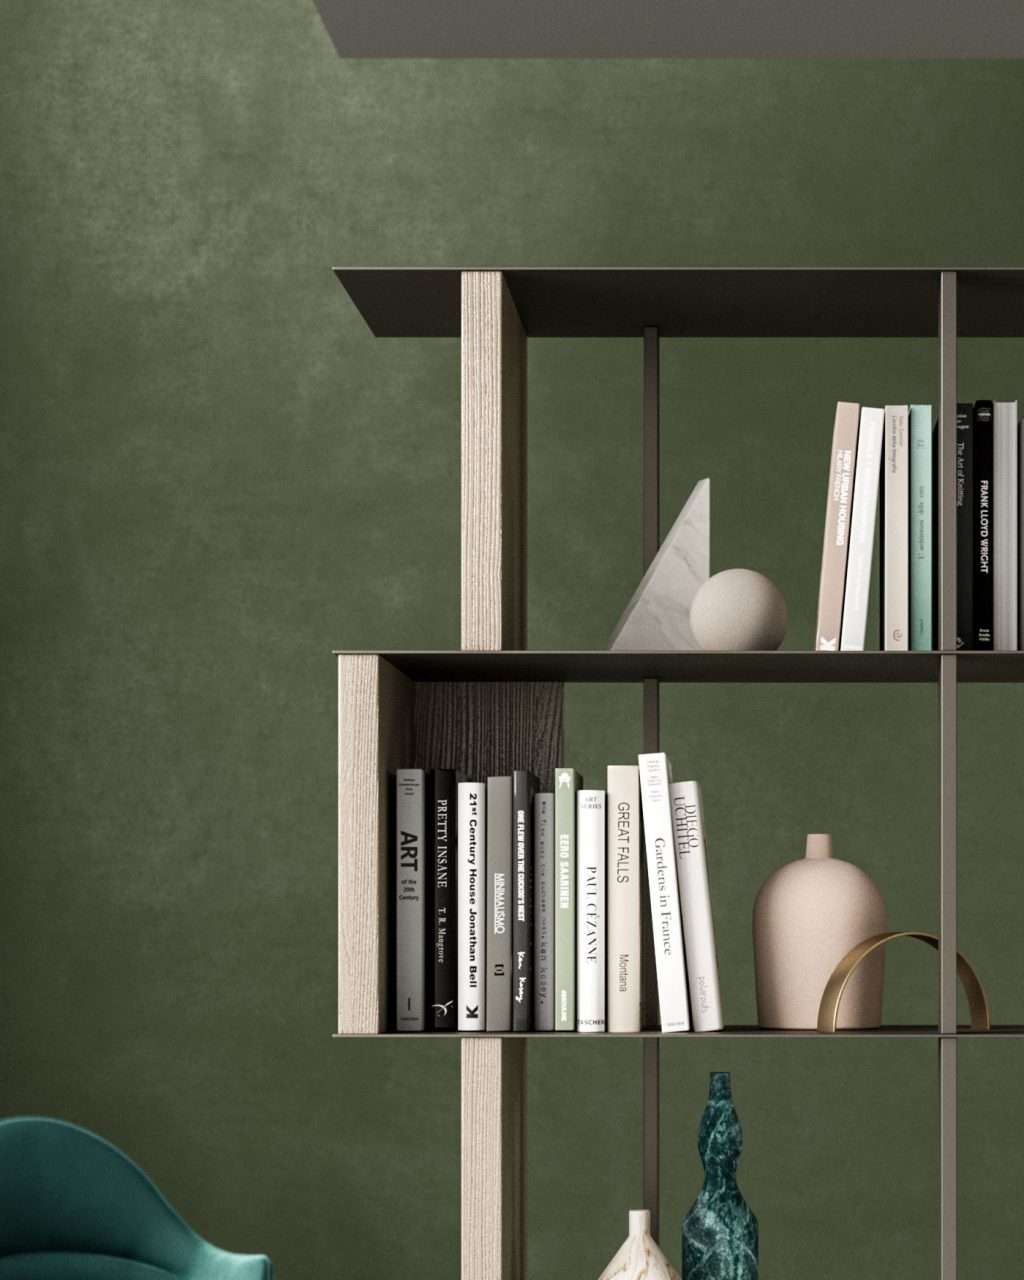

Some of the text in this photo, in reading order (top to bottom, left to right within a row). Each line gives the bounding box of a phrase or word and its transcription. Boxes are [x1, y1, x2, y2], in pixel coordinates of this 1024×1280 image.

[956, 442, 965, 455] The
[956, 457, 965, 469] Art
[835, 449, 853, 546] NEW URBAN HOUSING
[980, 480, 989, 574] FRANK LLOYD WRIGHT
[517, 810, 525, 823] ONE
[517, 824, 525, 842] FLEW
[672, 796, 691, 860] UCHITEL
[685, 803, 700, 849] DIEGO
[399, 831, 418, 872] ART
[436, 799, 447, 888] PRETTY INSANE
[517, 842, 525, 859] OVER
[617, 801, 630, 884] GREAT FALLS
[517, 860, 525, 873] THE
[559, 833, 569, 909] EERO SAARINEN
[467, 793, 478, 988] 21st Century House Jonathan Bell
[495, 873, 505, 934] MINIMALISMO
[654, 837, 674, 956] Gardens in France
[437, 917, 446, 925] R.
[517, 905, 525, 922] NEST
[586, 866, 602, 964] PAUL CÉZANNE
[436, 928, 446, 963] Mangrove
[618, 953, 629, 992] Montana
[466, 1005, 478, 1019] K
